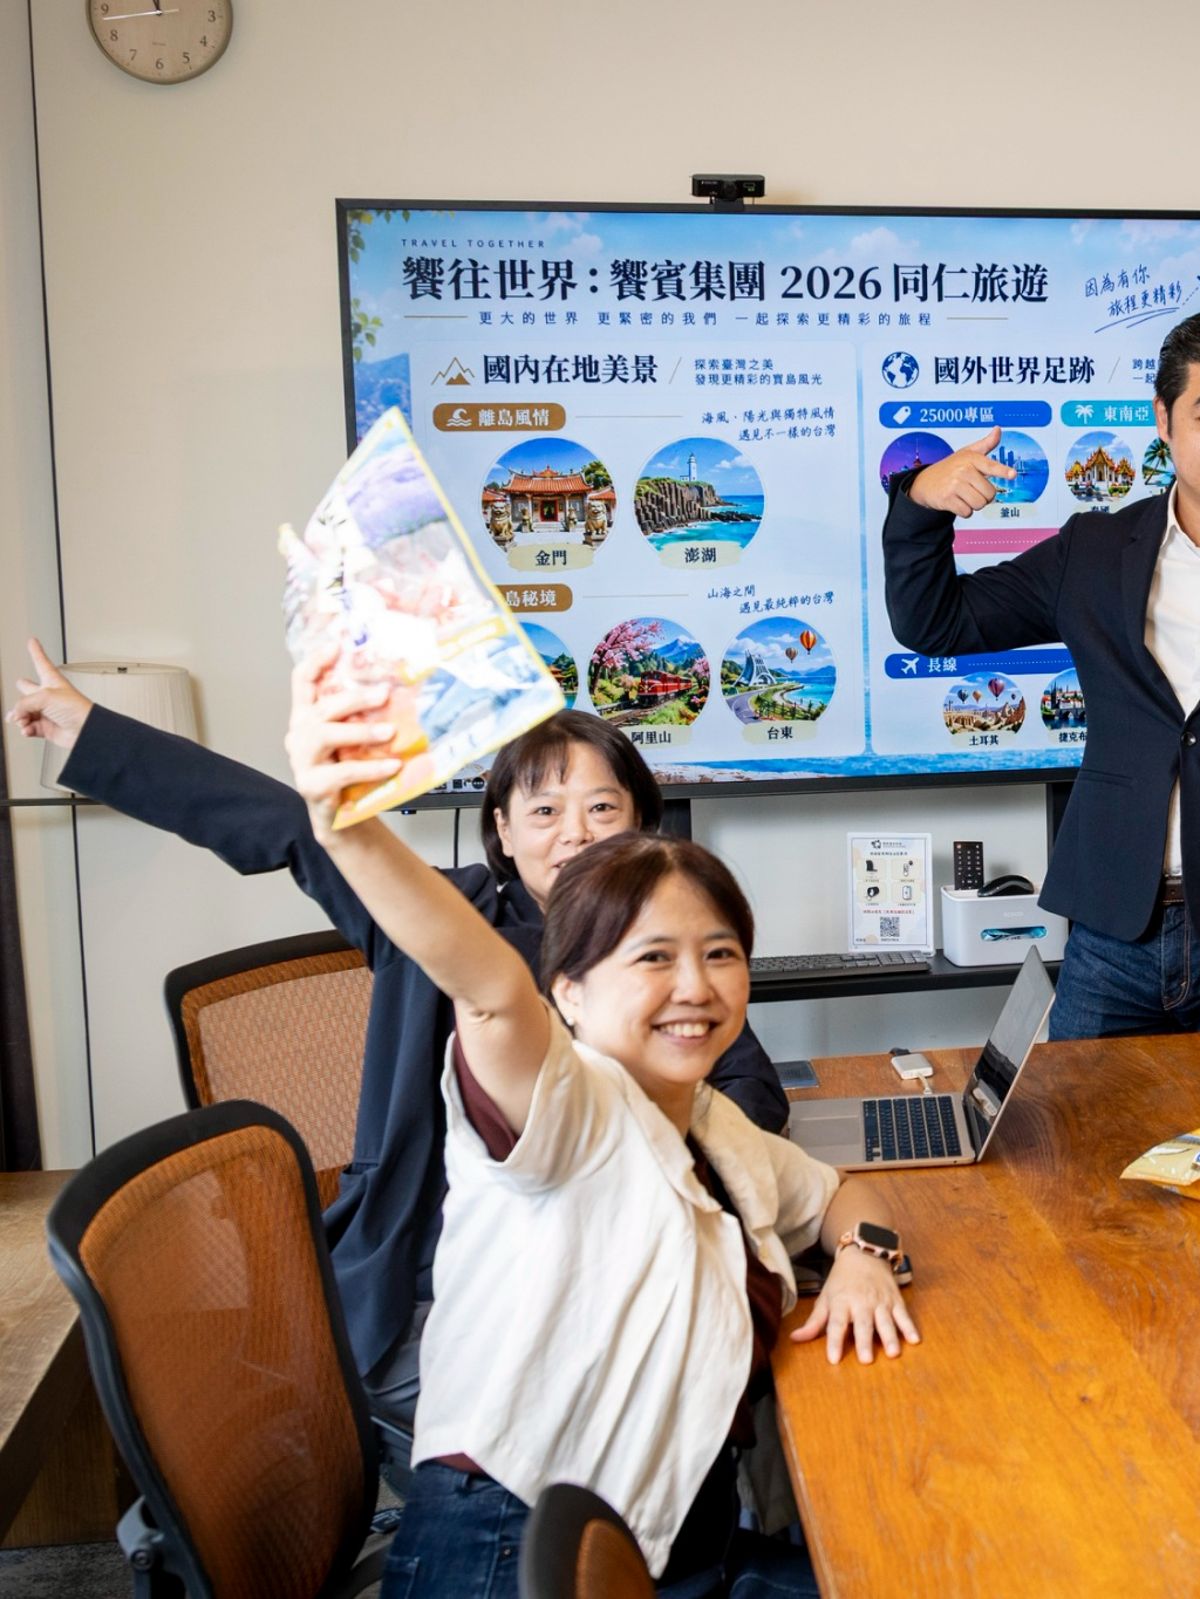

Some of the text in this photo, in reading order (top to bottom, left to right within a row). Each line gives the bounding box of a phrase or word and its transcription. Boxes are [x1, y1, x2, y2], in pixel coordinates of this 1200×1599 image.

[100, 4, 109, 15] 9
[207, 10, 216, 22] 3
[110, 29, 118, 41] 8
[200, 35, 207, 47] 4
[129, 49, 137, 61] 7
[182, 52, 190, 63] 5
[155, 58, 164, 70] 6
[401, 239, 545, 248] TRAVEL TOGETHER
[781, 265, 882, 301] 2026
[893, 263, 1049, 302] 同仁旅遊
[1085, 264, 1150, 297] 因為有你
[1108, 281, 1182, 317] 旅程更精彩
[479, 312, 933, 325] 更大的世界 更緊密的我們 一起探索更精彩的旅程
[483, 354, 658, 385] 國內在地美景
[694, 359, 774, 371] 探索臺灣之美
[934, 356, 1095, 385] 國外世界足跡
[695, 373, 823, 386] 發現更精彩的寶島風光
[478, 409, 550, 427] 離島風情
[919, 406, 995, 424] 25000專區
[1104, 405, 1150, 422] 東南亞
[738, 424, 836, 442] 遇見不一樣的台灣
[535, 549, 567, 567] 金門
[684, 547, 717, 565] 澎湖
[707, 584, 756, 599] 山海之間
[740, 591, 834, 614] 遇見最純粹的台灣
[927, 657, 958, 673] 長線
[631, 730, 672, 744] 阿里山
[766, 726, 793, 740] 台東
[969, 735, 999, 746] 土耳其
